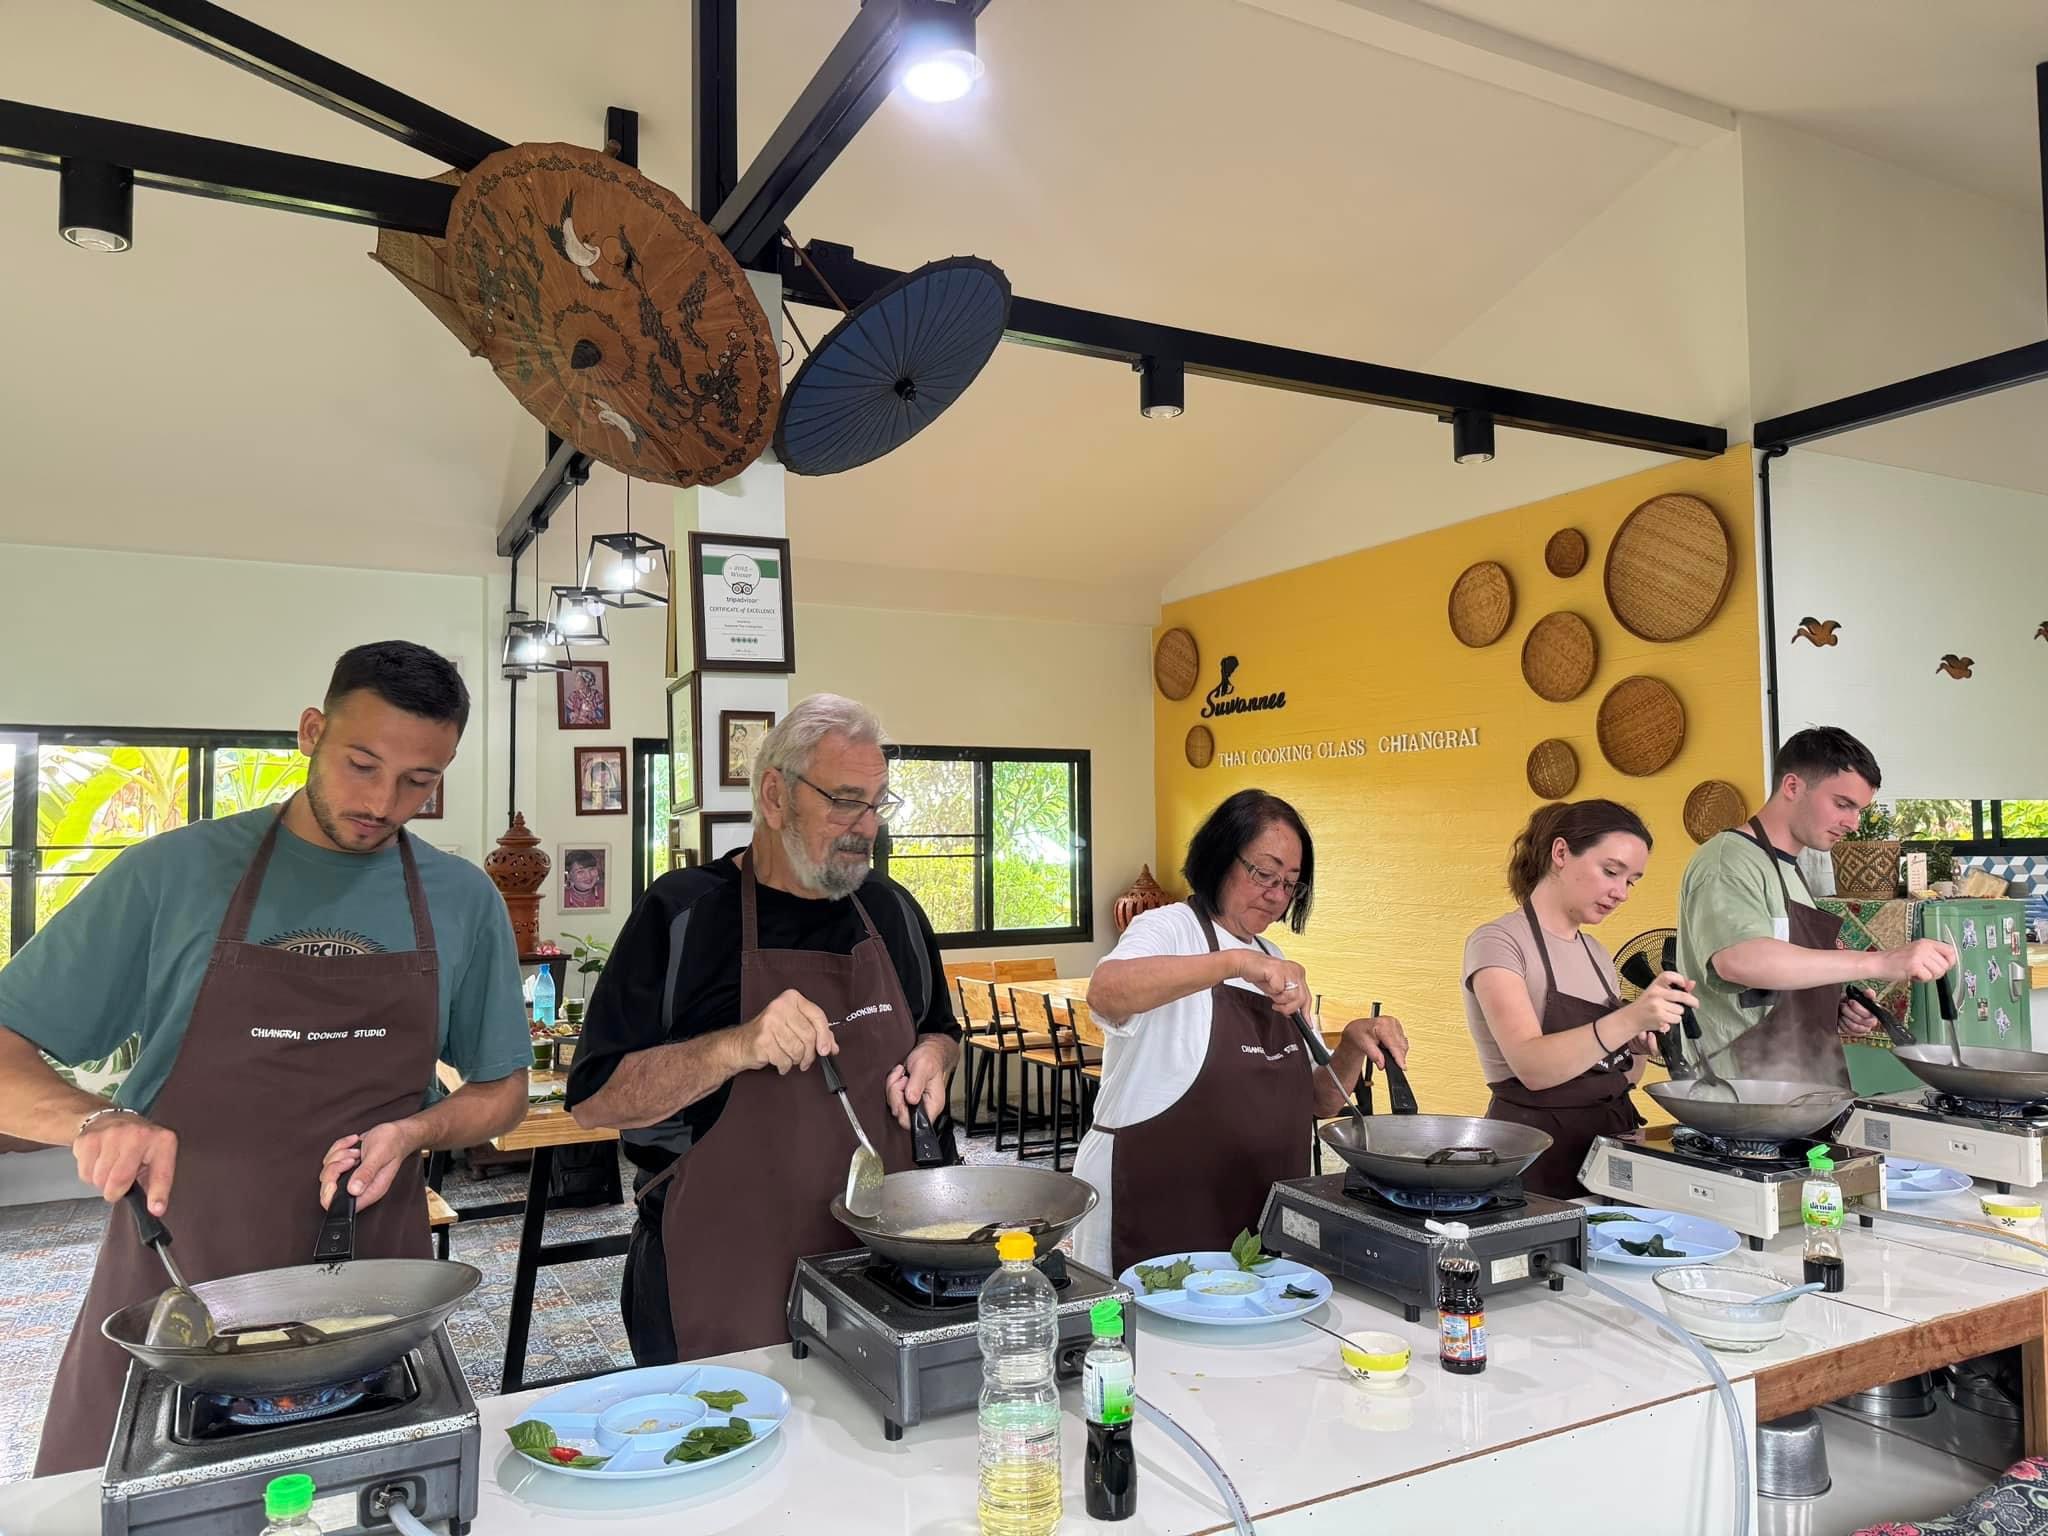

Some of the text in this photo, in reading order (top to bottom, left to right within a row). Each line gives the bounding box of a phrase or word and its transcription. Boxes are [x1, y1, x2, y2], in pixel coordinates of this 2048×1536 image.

[746, 607, 776, 615] EXCELLENCE
[1201, 685, 1287, 719] Suwannee
[1218, 727, 1480, 768] THAI COOKING CLASS CHIANGRAI
[846, 1005, 878, 1021] COOKING
[251, 1027, 387, 1040] CHIANGRAI COOKING STUDIO
